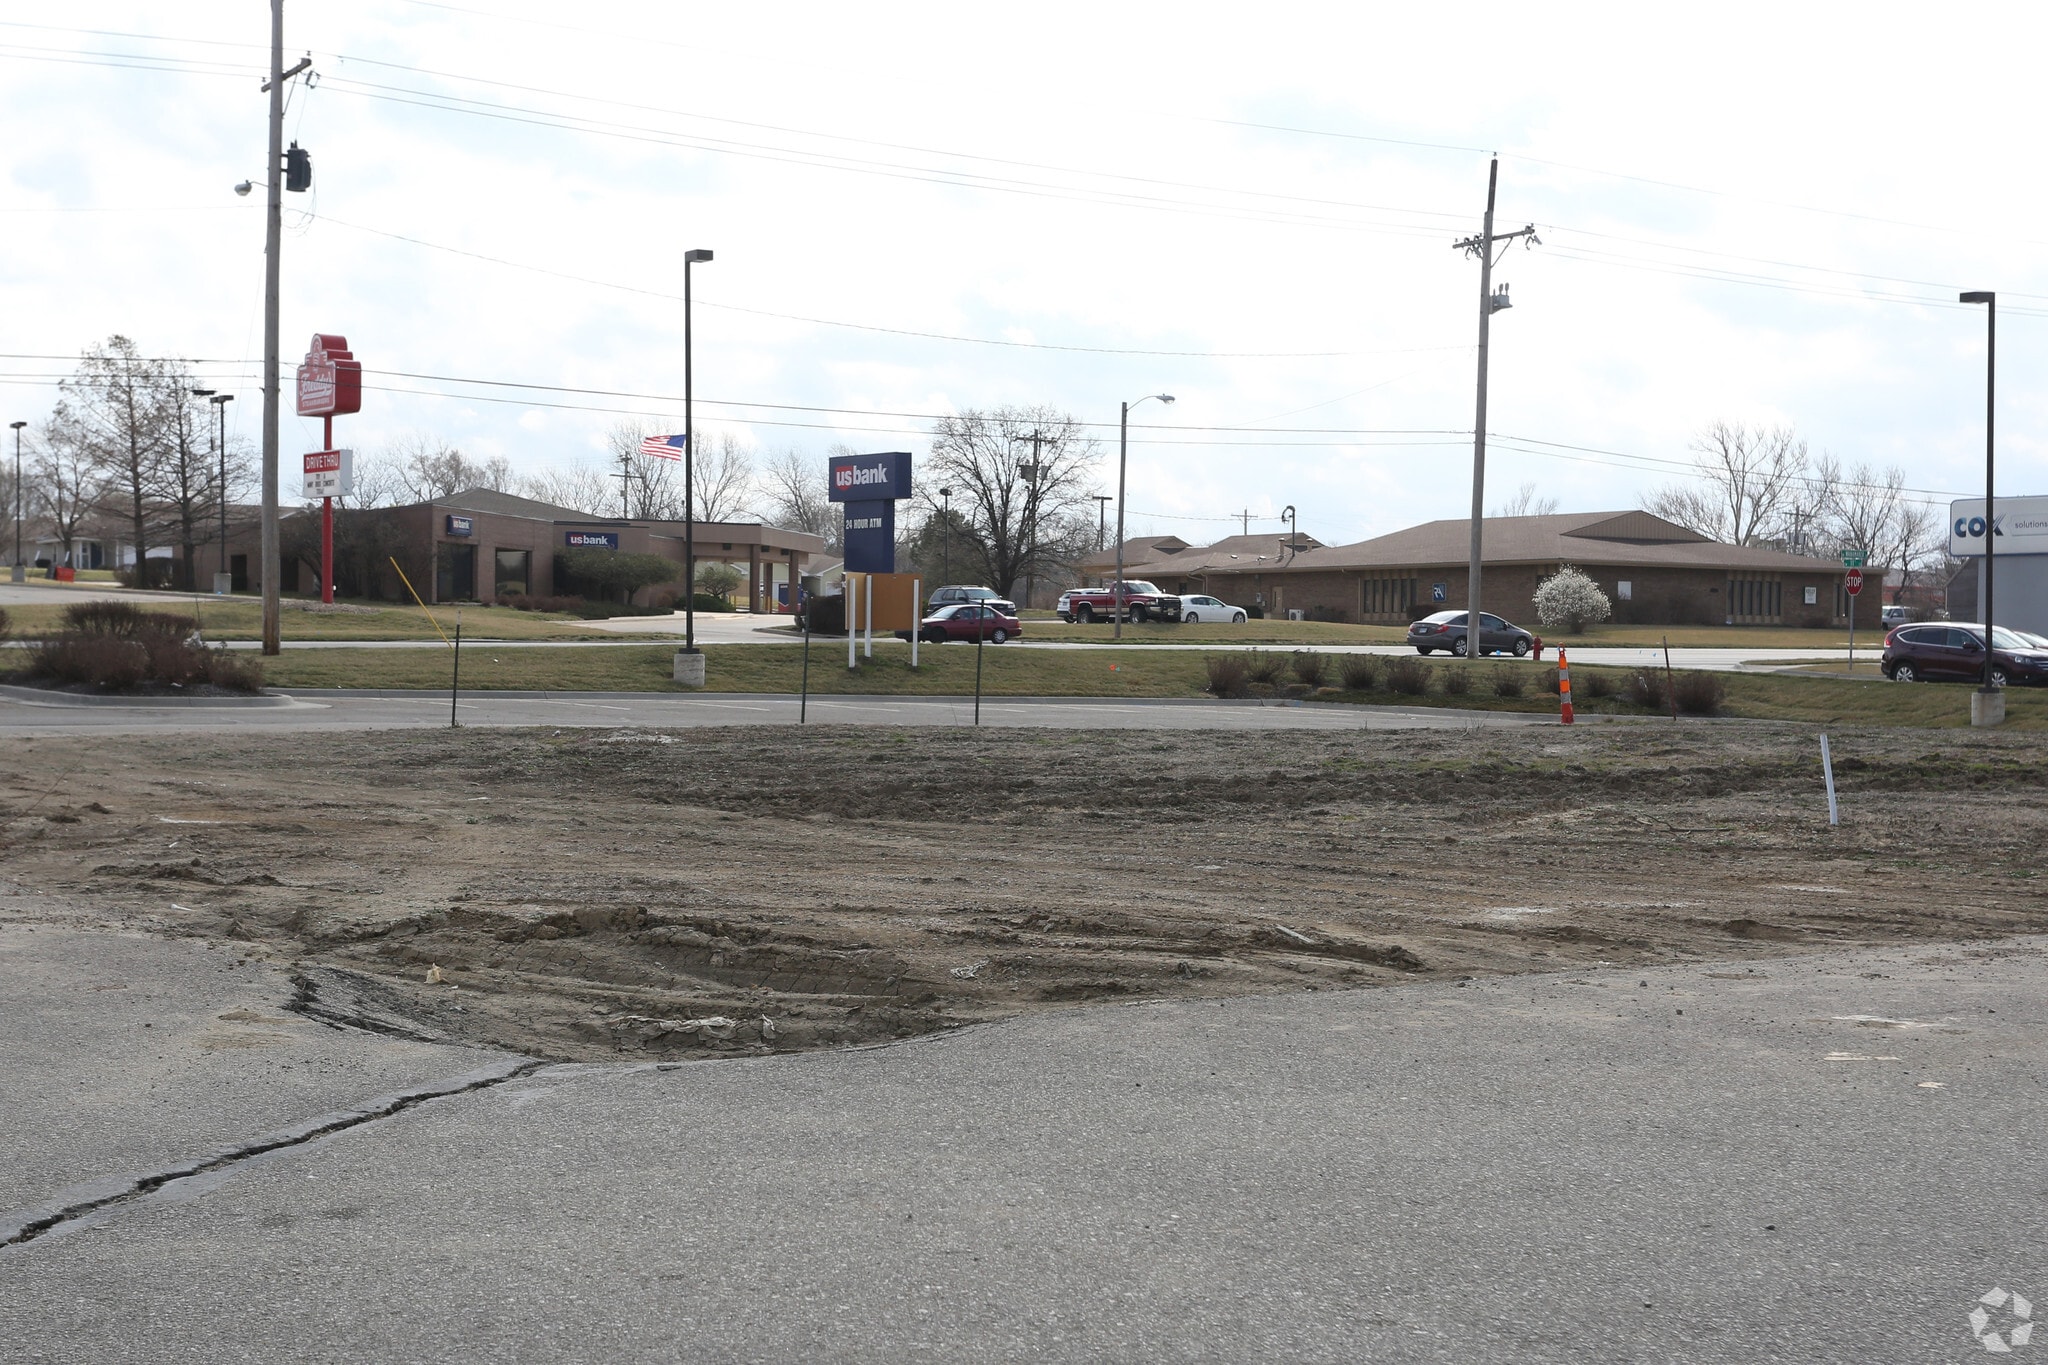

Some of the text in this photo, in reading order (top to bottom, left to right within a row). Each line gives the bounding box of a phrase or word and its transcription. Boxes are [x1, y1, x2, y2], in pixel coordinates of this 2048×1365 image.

[306, 453, 338, 470] DRIVE THRU
[846, 518, 882, 530] 24 HOUR ATM
[1846, 576, 1862, 587] STOP
